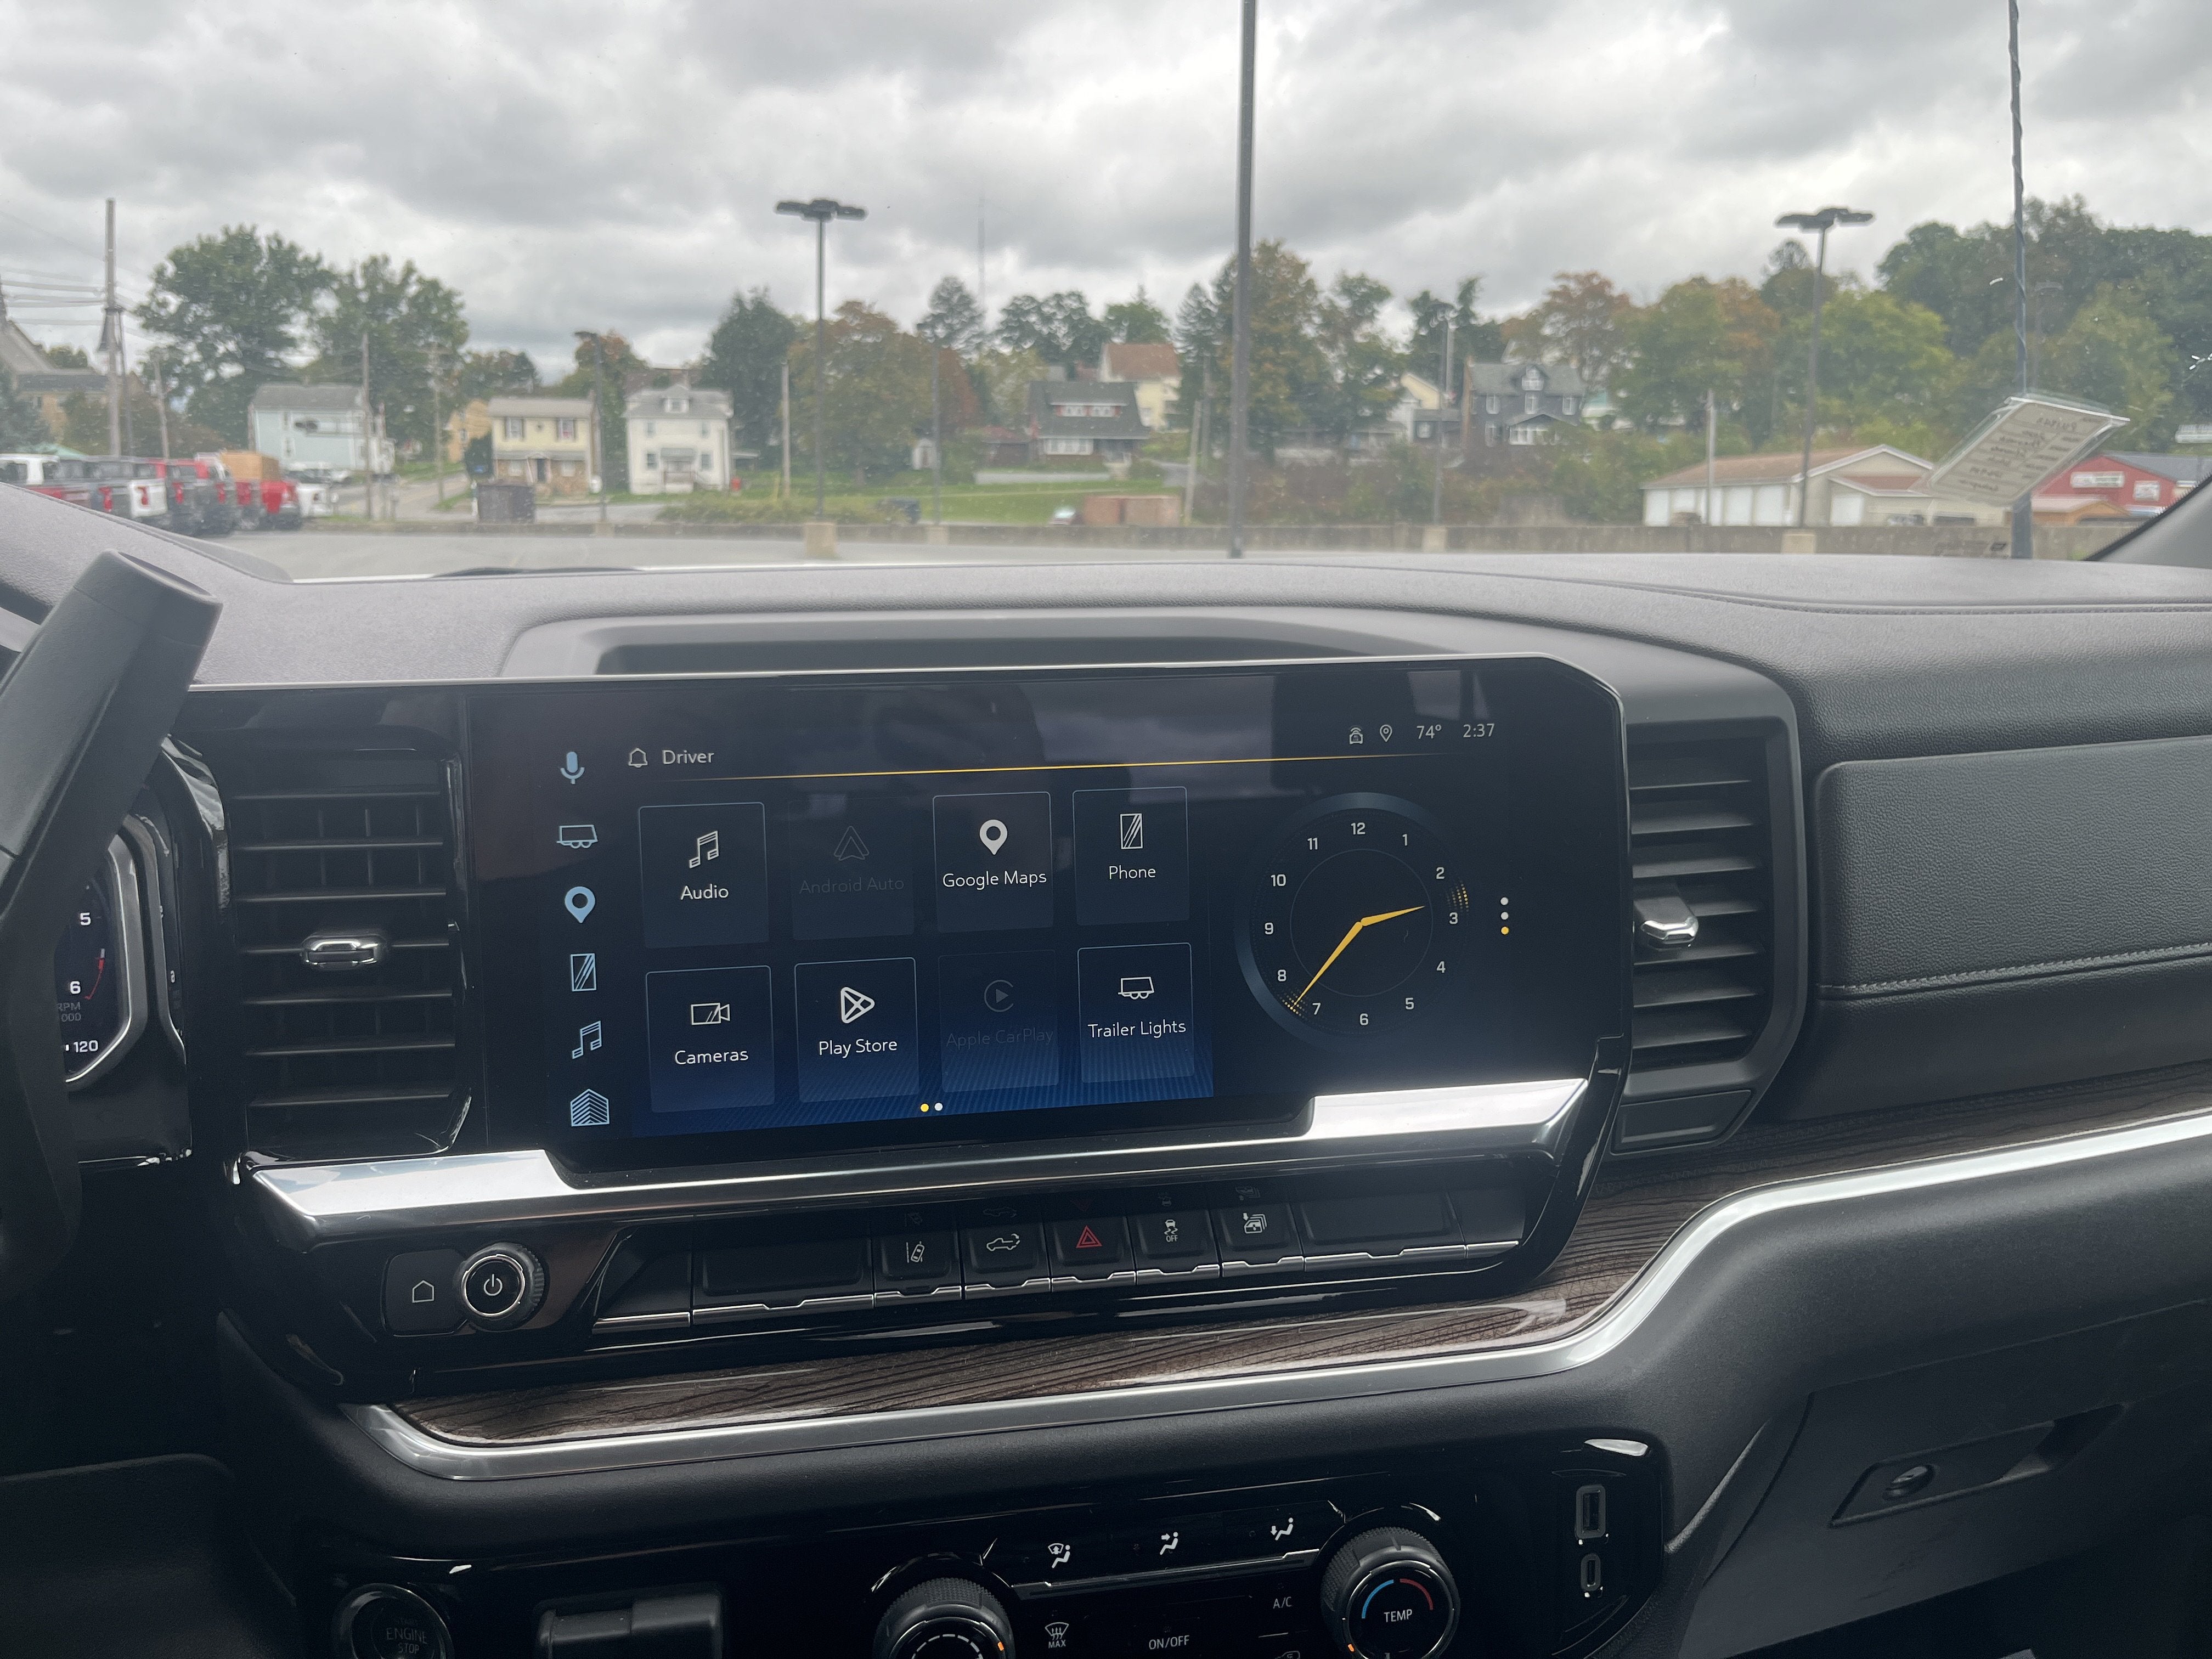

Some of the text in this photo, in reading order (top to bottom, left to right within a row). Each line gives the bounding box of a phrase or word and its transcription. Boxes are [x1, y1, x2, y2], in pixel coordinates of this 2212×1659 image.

[1463, 723, 1495, 738] 2:37
[662, 749, 714, 765] Driver
[1351, 822, 1365, 835] 12
[1307, 837, 1318, 850] 11
[1402, 833, 1408, 846] 1
[1109, 865, 1156, 879] Phone
[1436, 867, 1445, 879] 2
[799, 877, 904, 894] Android Auto
[943, 870, 1047, 890] Google Maps
[1271, 874, 1286, 887] 10
[680, 883, 729, 900] Audio
[80, 912, 91, 926] 5
[1449, 912, 1458, 924] 3
[1265, 922, 1274, 935] 9
[1436, 961, 1446, 973] 4
[1277, 969, 1286, 982] 8
[70, 981, 81, 994] 6
[1312, 1002, 1321, 1015] 7
[1405, 997, 1414, 1010] 5
[1359, 1013, 1369, 1026] 6
[1087, 1019, 1186, 1039] Trailer Lights
[946, 1027, 1054, 1049] Apple CarPlay
[73, 1040, 98, 1053] 120
[819, 1039, 898, 1059] Play Store
[674, 1050, 749, 1065] Cameras
[1273, 1596, 1292, 1609] A/C
[1384, 1609, 1413, 1622] TEMP
[386, 1627, 428, 1644] ENGINE
[1148, 1634, 1189, 1650] ON/OFF
[398, 1643, 419, 1654] STOP
[1048, 1640, 1066, 1648] MAX
